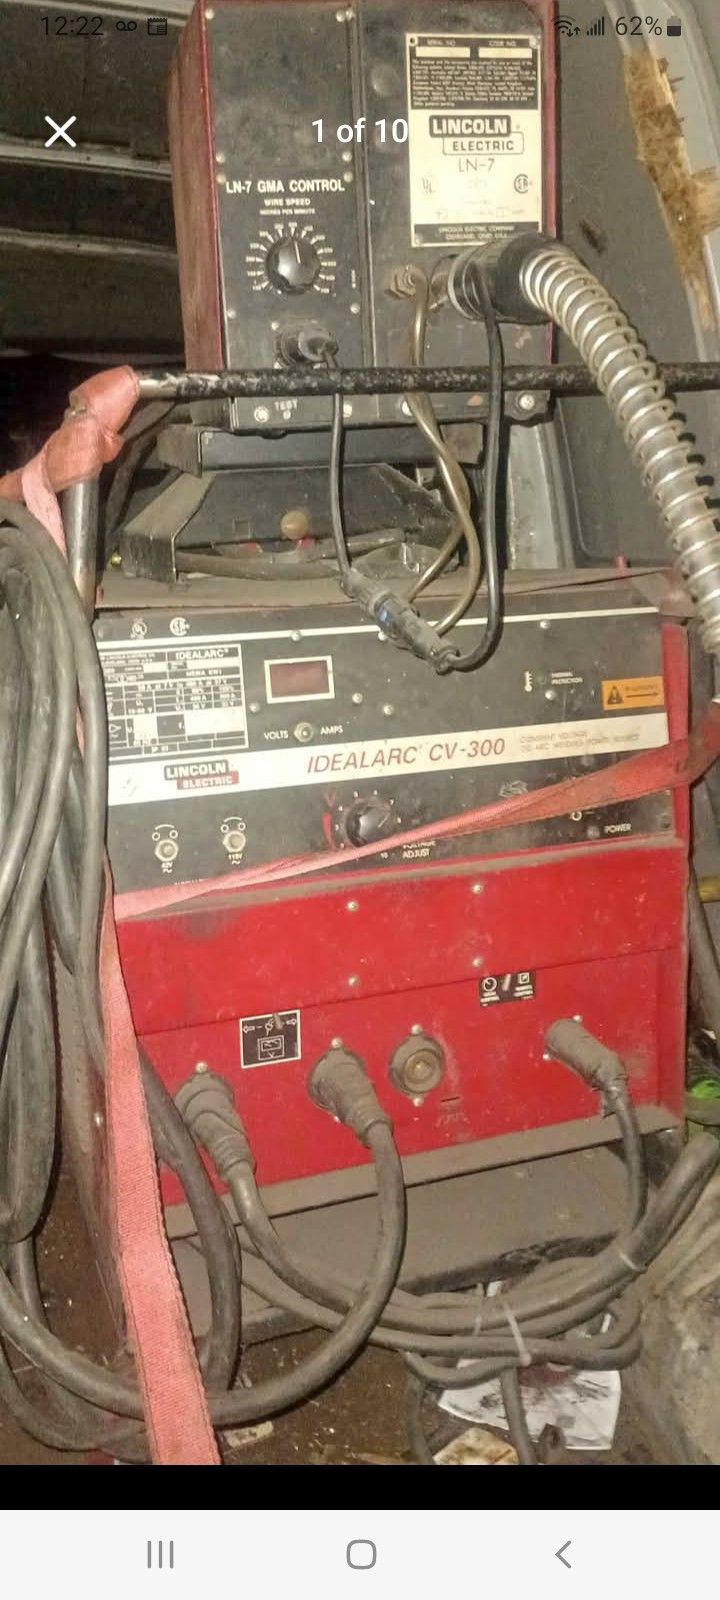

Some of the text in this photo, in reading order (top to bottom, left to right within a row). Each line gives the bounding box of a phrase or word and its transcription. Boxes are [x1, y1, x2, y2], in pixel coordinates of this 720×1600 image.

[432, 118, 508, 134] LINCOLN
[452, 140, 515, 152] ELECTRIC
[458, 158, 495, 172] LN-7
[225, 178, 346, 194] LN-7 GMA CONTROL
[263, 198, 311, 206] WIRE SPEED
[263, 725, 343, 740] VOLTS AMPS
[307, 738, 506, 773] IDEALARC CV-300
[165, 762, 226, 779] LINCOLN
[182, 775, 233, 788] ELECTRIC
[603, 823, 632, 833] POWER
[402, 848, 430, 859] ADJUST
